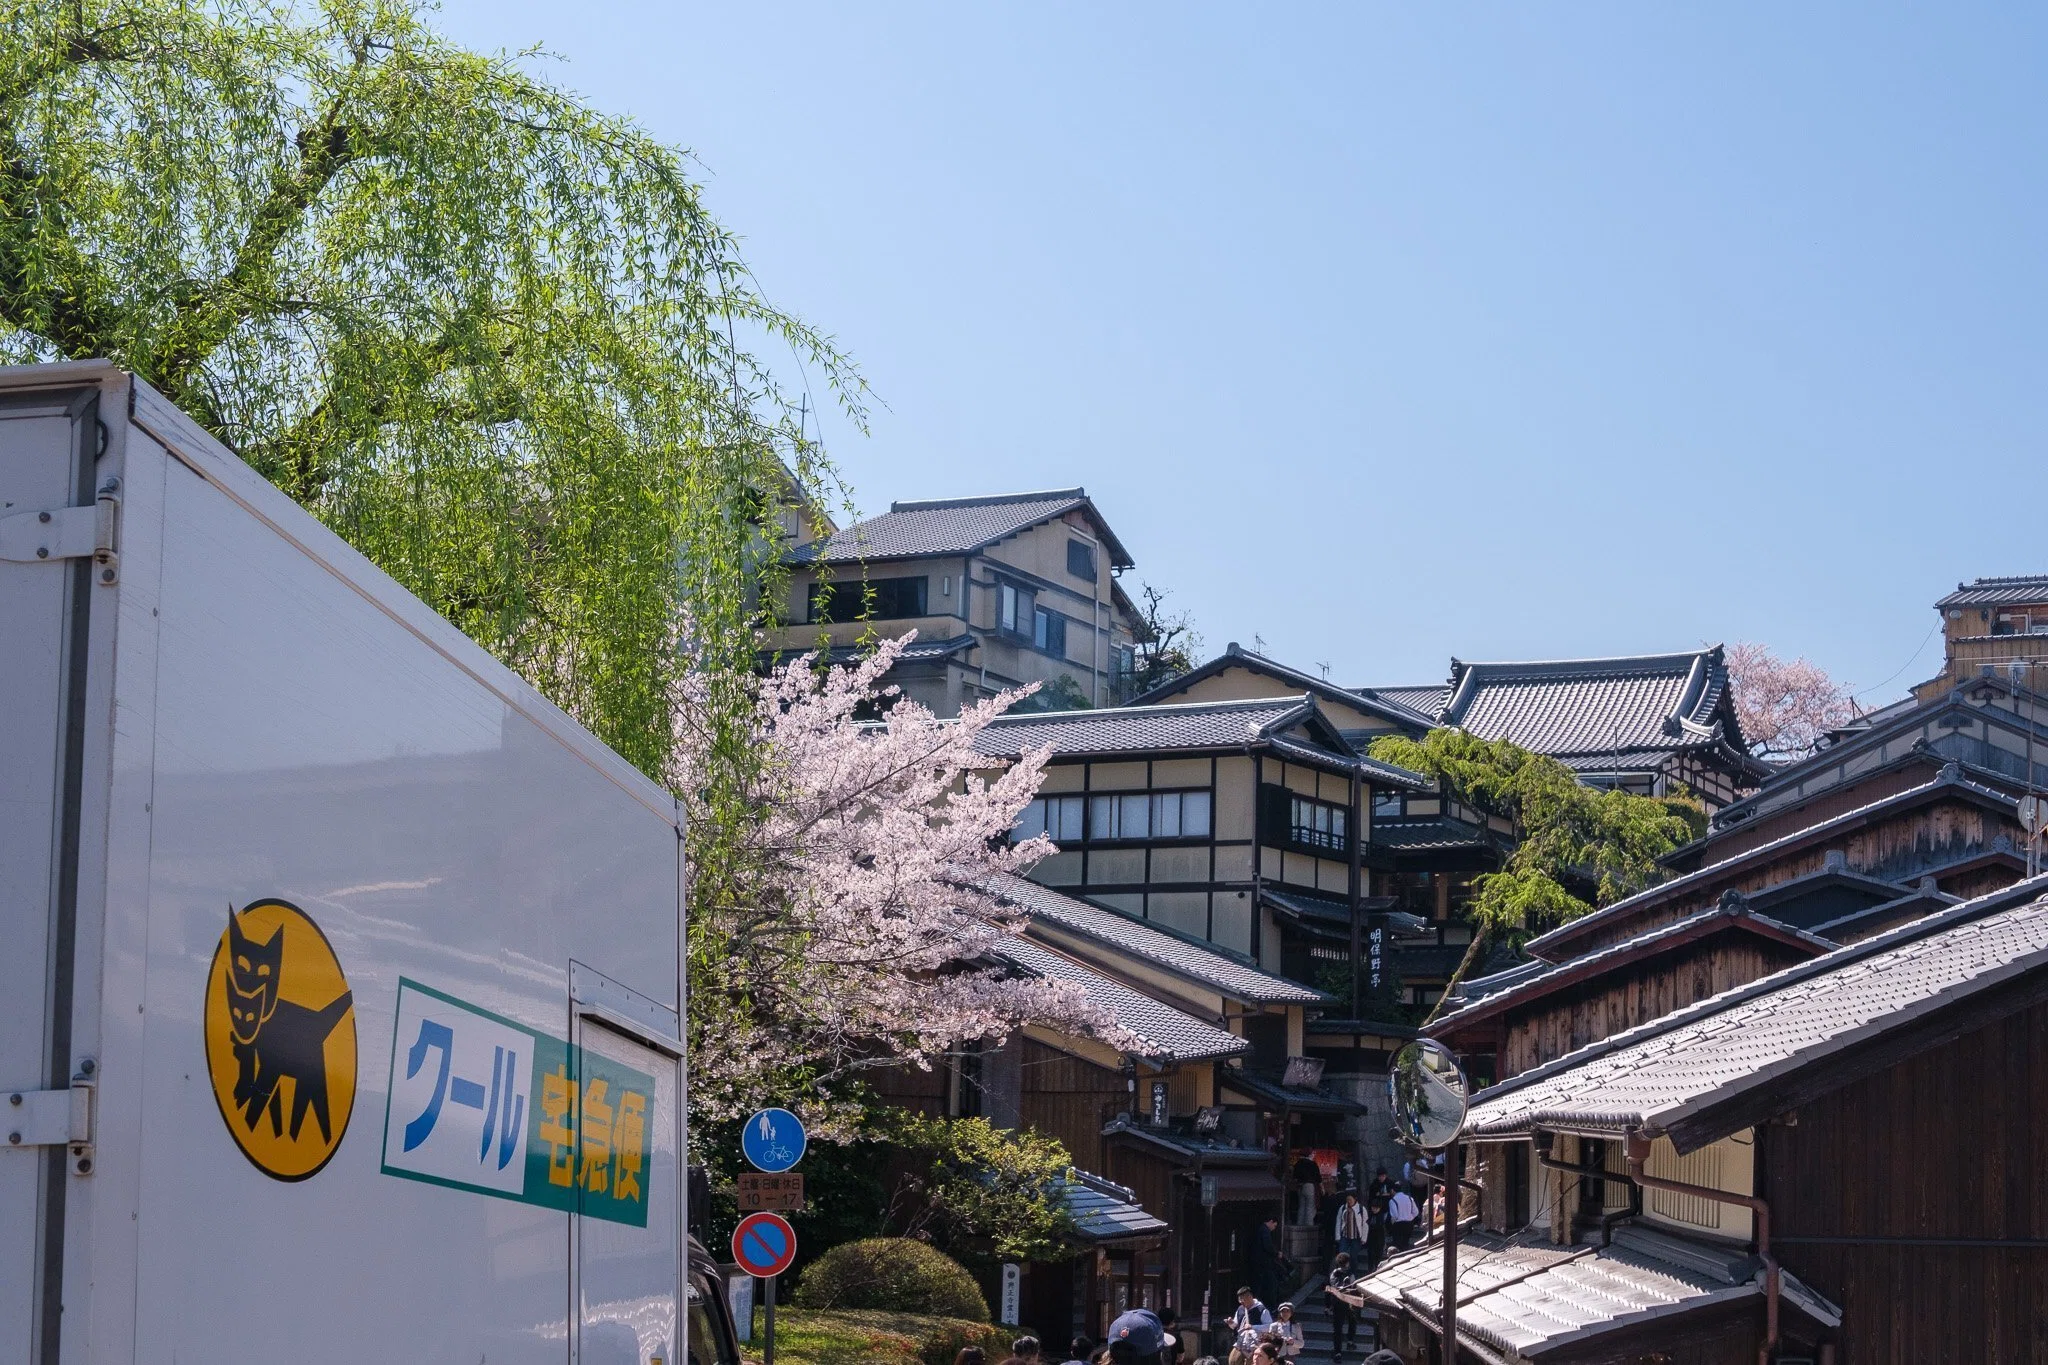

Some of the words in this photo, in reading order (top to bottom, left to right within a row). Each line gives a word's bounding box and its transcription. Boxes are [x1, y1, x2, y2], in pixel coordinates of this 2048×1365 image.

[1370, 928, 1381, 988] 明保野亭
[403, 1018, 525, 1172] クール
[539, 1063, 648, 1204] 宅急便
[745, 1193, 761, 1205] 10
[782, 1193, 797, 1205] 17
